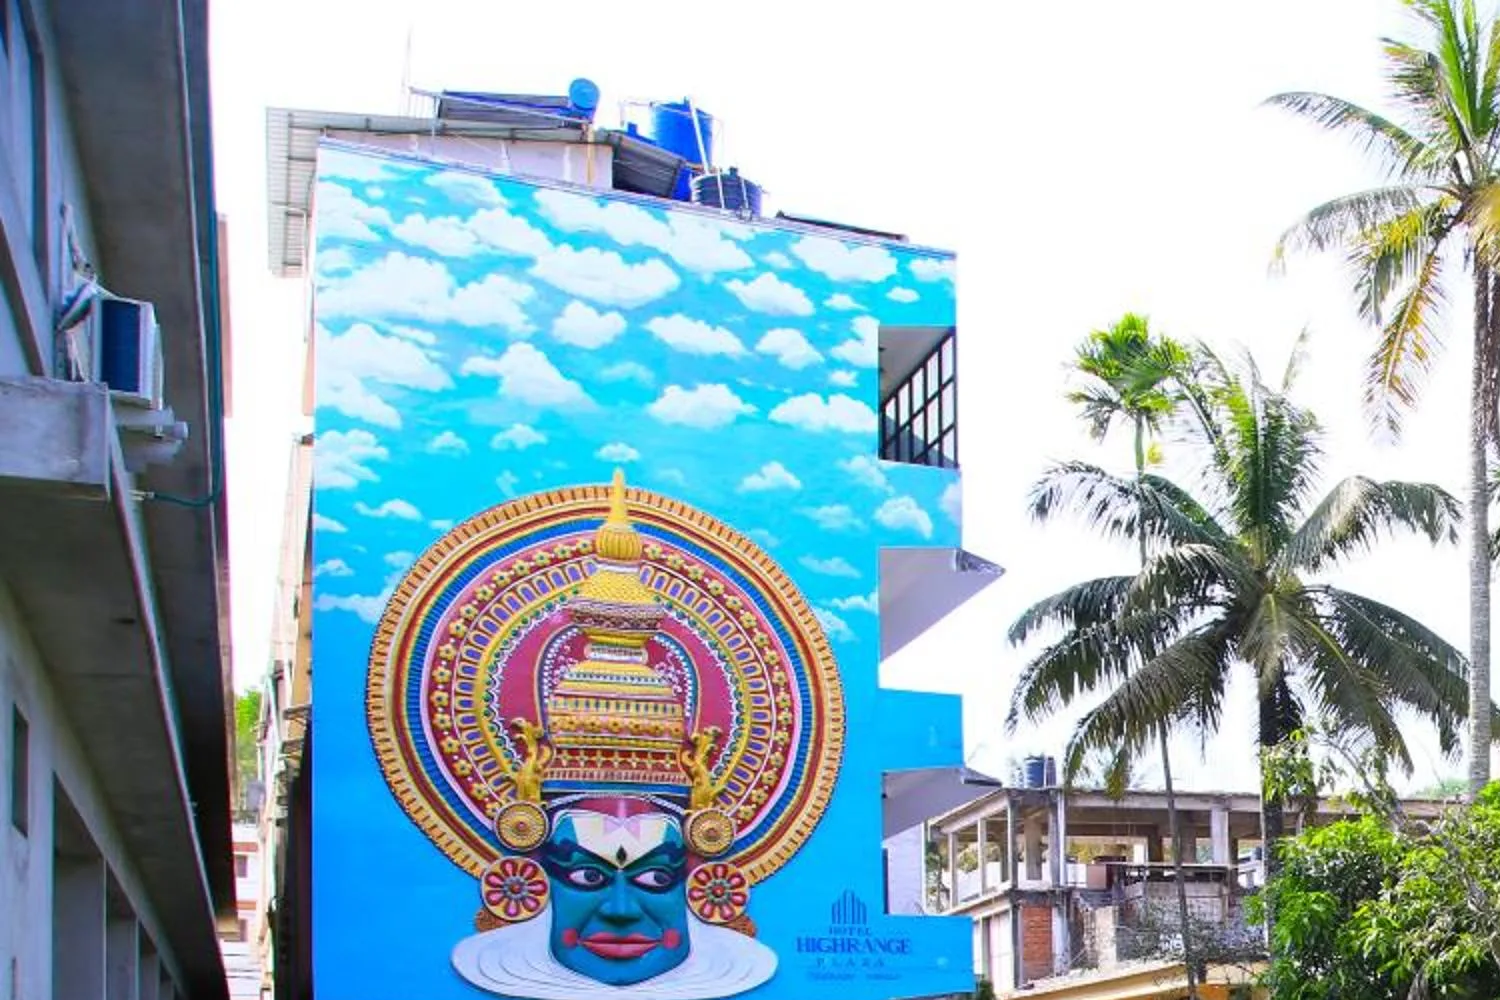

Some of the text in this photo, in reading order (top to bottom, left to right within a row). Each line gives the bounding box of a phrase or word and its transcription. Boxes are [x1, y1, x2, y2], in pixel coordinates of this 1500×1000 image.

[828, 926, 872, 936] HOTEL
[796, 936, 912, 954] HIGHRANGE
[816, 957, 885, 968] PLAZA
